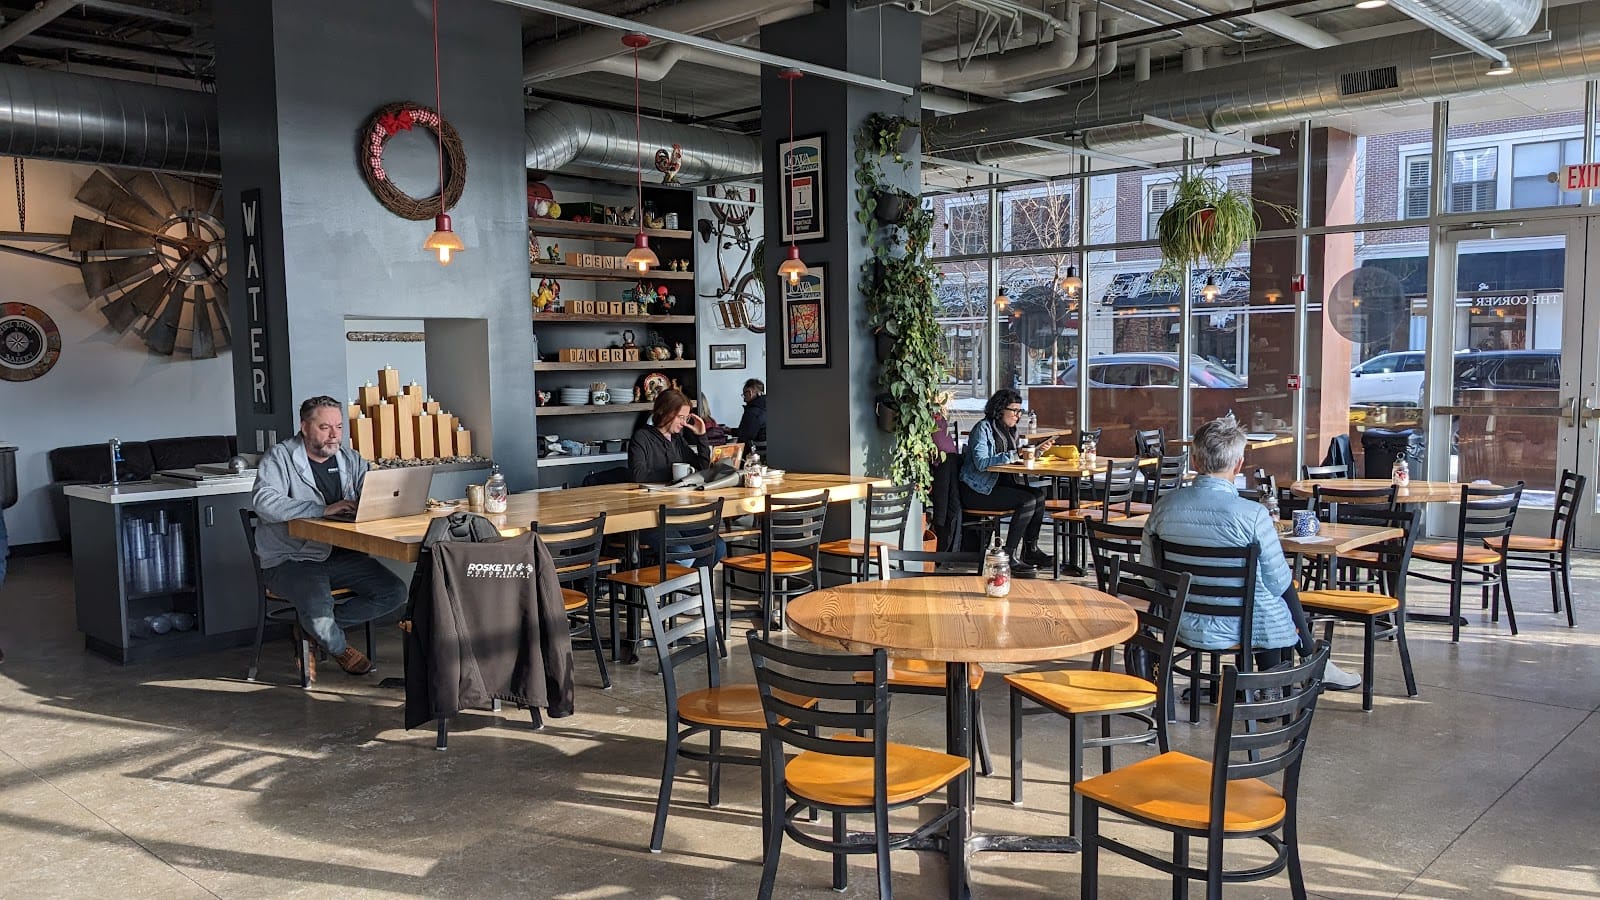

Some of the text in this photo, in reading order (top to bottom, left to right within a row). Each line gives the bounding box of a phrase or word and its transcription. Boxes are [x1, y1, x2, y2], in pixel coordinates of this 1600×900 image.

[1568, 163, 1600, 189] EXIT
[798, 191, 806, 204] L
[243, 201, 267, 403] WATER
[576, 302, 635, 314] ROUTE
[571, 350, 635, 361] BAKERY
[468, 563, 515, 571] ROSKE.TV
